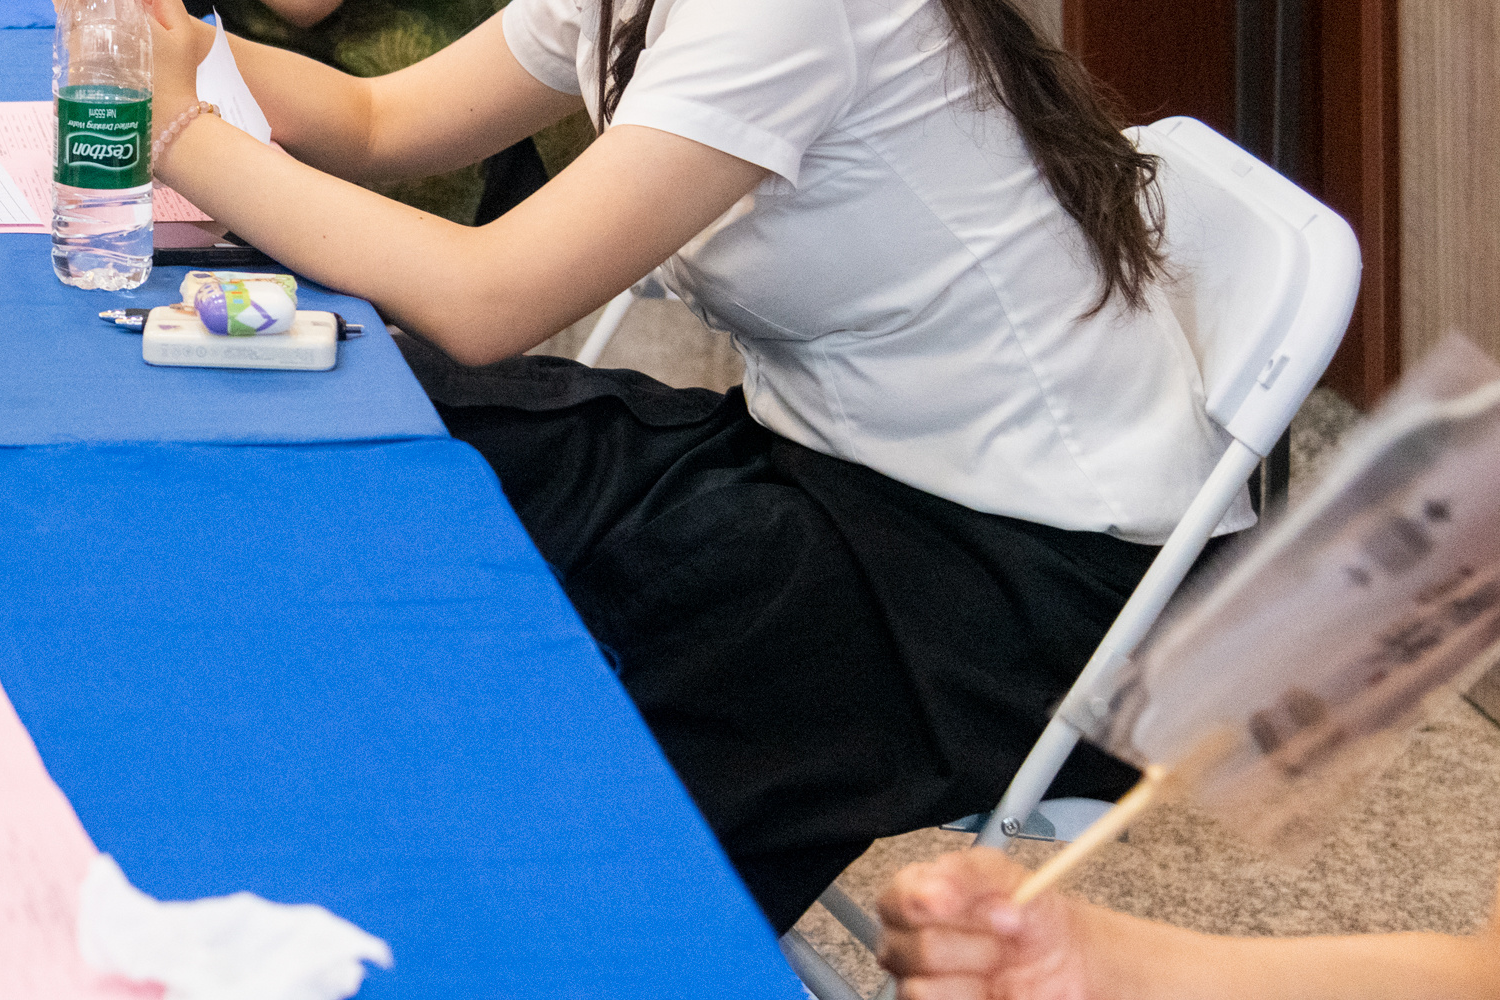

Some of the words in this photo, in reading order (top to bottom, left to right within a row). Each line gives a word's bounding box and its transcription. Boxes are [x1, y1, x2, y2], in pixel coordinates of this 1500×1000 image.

[106, 108, 117, 119] Net
[67, 120, 85, 129] Water
[86, 120, 113, 131] Drinking
[114, 121, 138, 130] Purified
